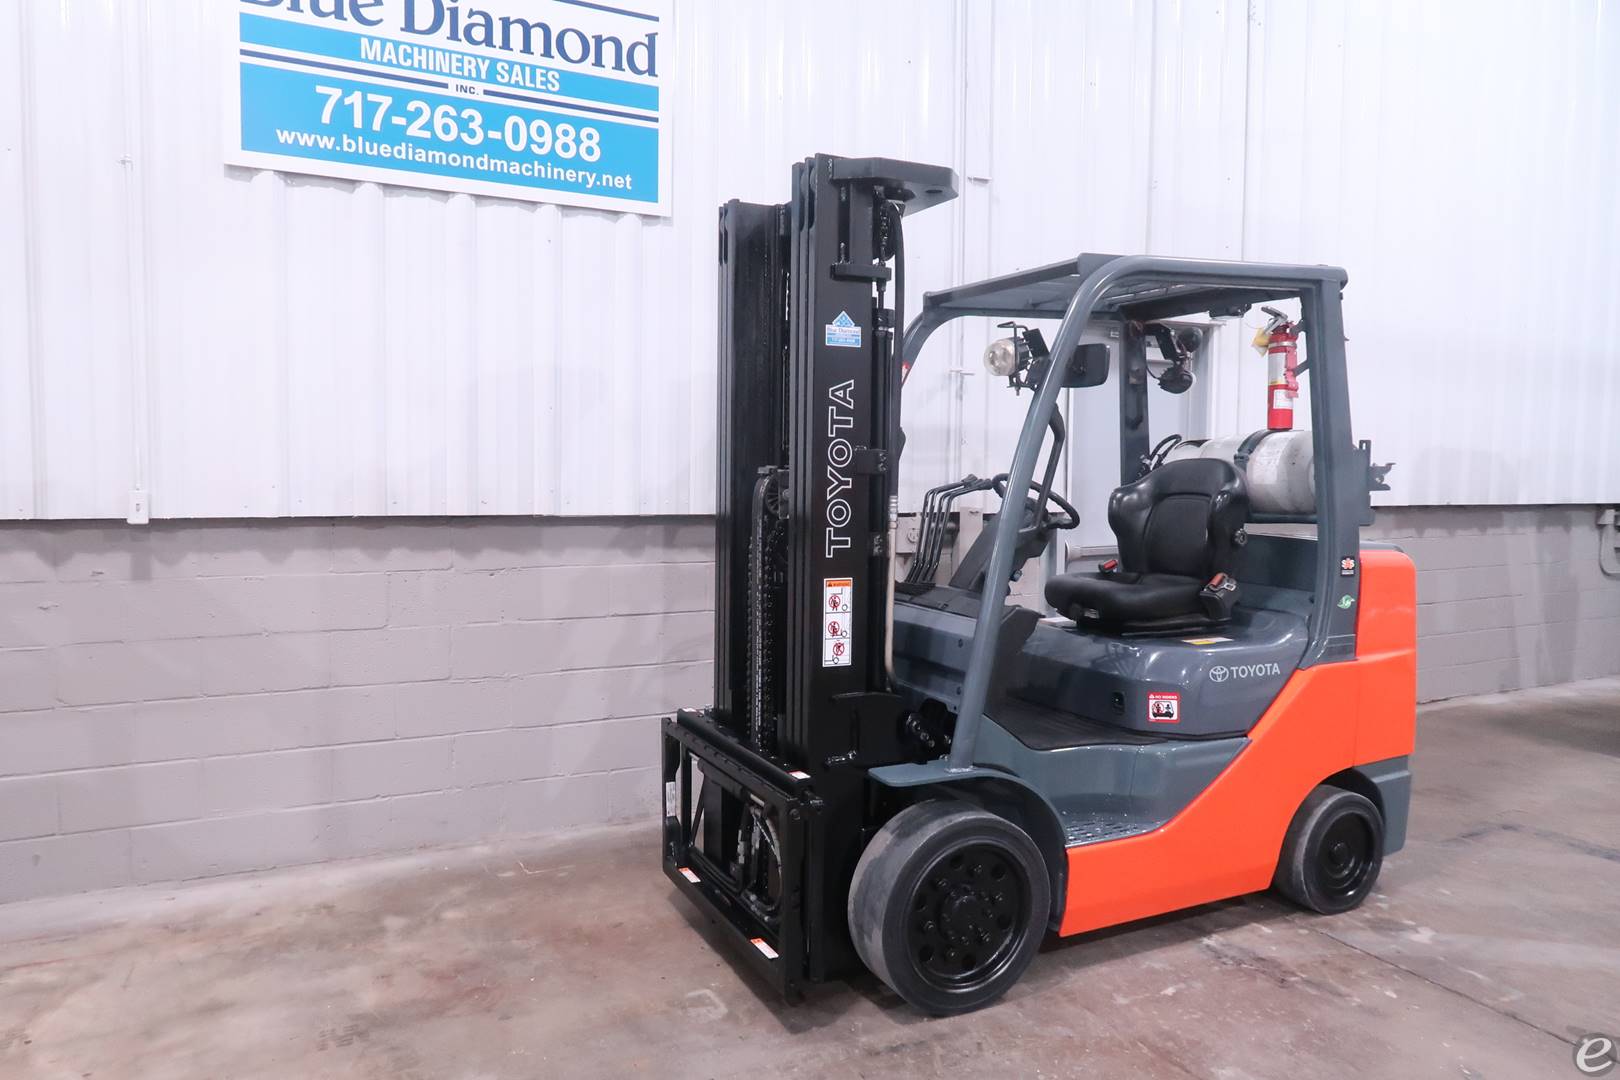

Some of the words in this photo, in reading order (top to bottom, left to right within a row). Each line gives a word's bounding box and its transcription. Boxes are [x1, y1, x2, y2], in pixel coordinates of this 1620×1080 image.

[360, 37, 489, 79] MACHINERY
[496, 62, 560, 91] SALES
[400, 0, 659, 77] Diamond
[455, 84, 479, 95] INC.
[315, 85, 601, 163] 717-263-0988
[276, 129, 633, 190] www.bluediamondmachinery.net
[825, 379, 855, 558] TOYOTA
[1230, 663, 1281, 678] TOYOTA
